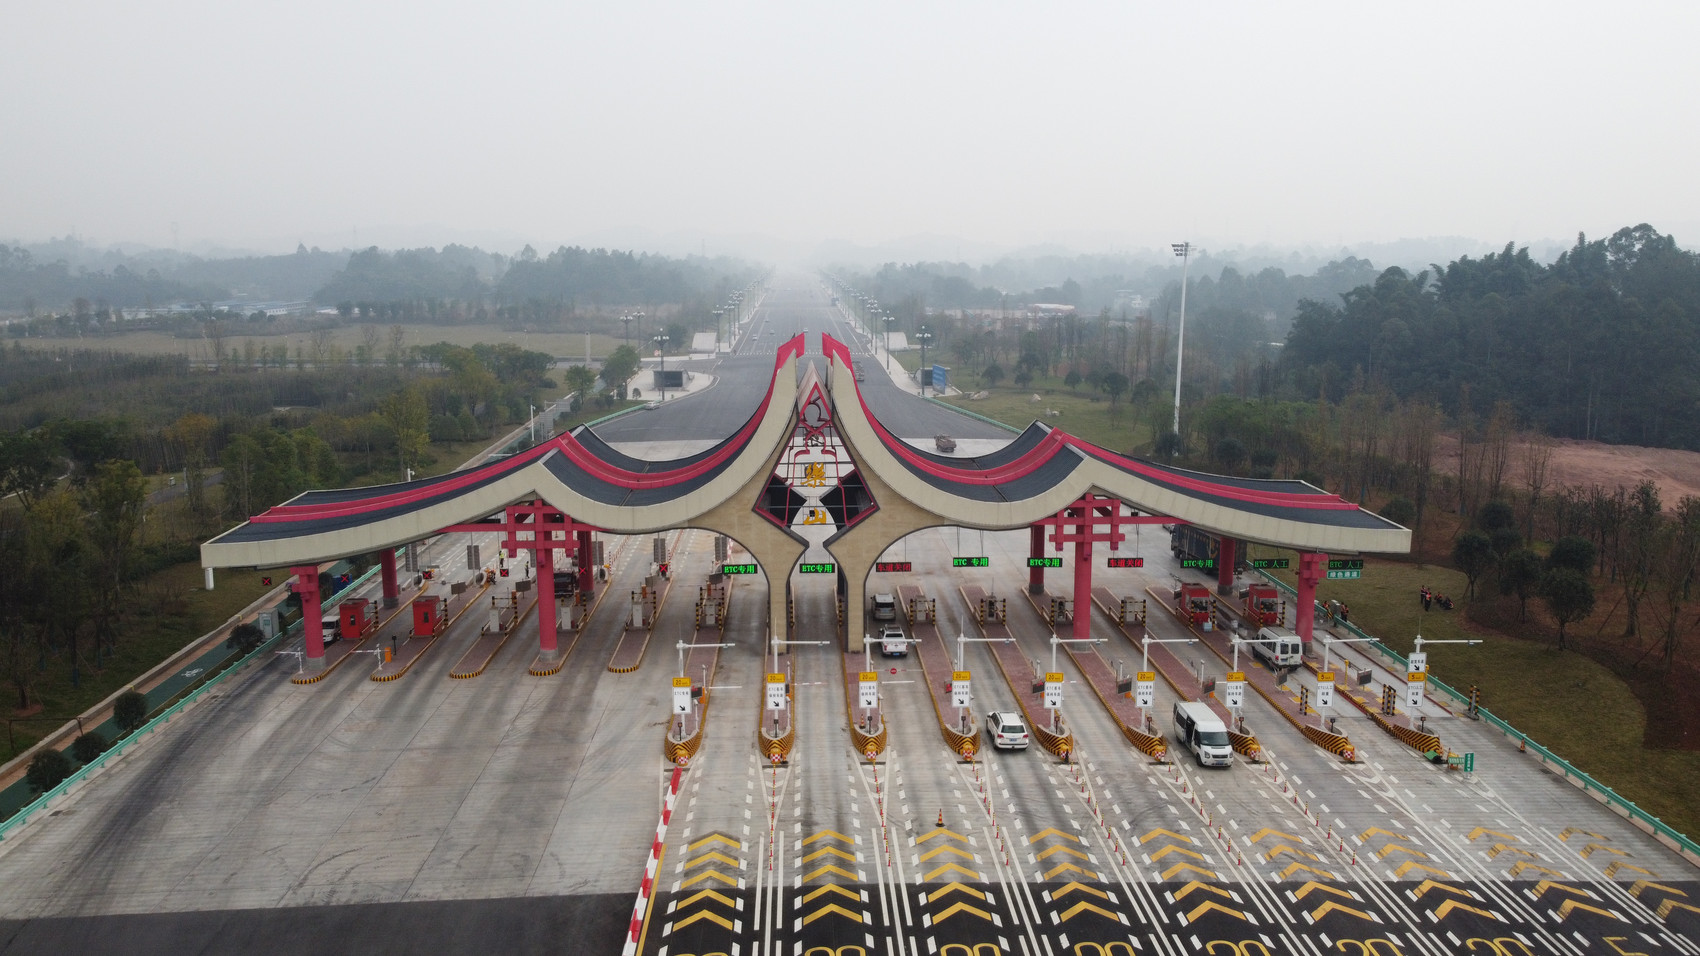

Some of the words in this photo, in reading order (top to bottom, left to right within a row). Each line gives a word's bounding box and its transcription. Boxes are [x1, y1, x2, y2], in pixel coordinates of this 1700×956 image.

[1109, 558, 1143, 567] 车道关闭
[878, 563, 911, 572] 车道关闭
